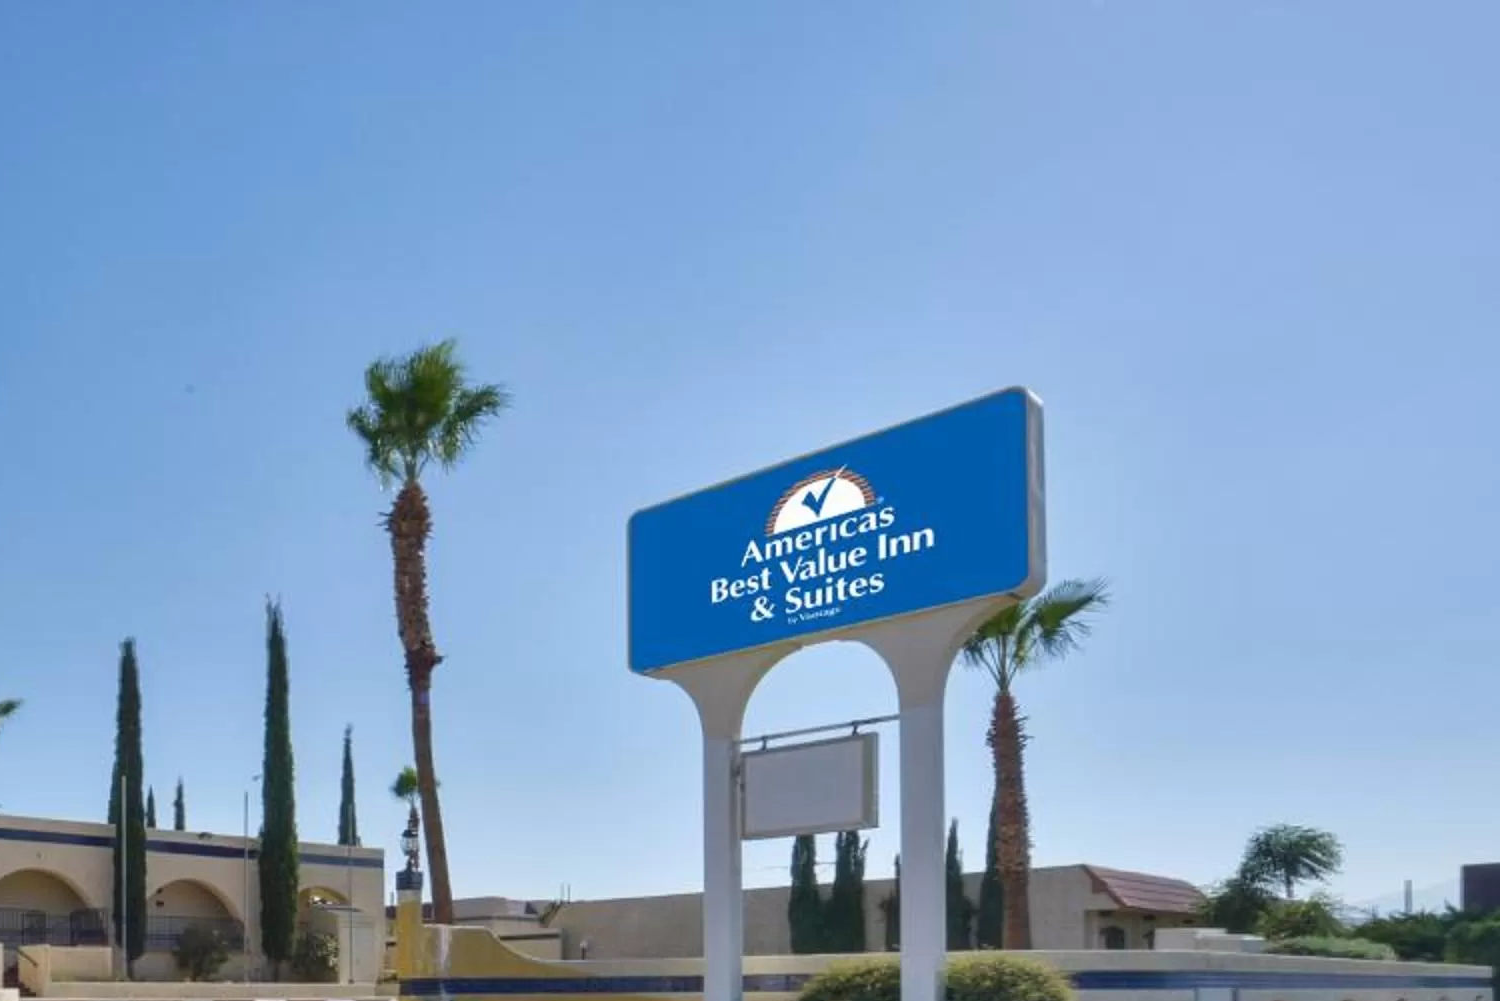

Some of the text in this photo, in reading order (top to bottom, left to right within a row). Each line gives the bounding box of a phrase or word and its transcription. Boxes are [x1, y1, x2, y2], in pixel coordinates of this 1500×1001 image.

[710, 527, 935, 604] Best Value Inn
[741, 505, 895, 567] Americas
[750, 572, 885, 622] & Suites
